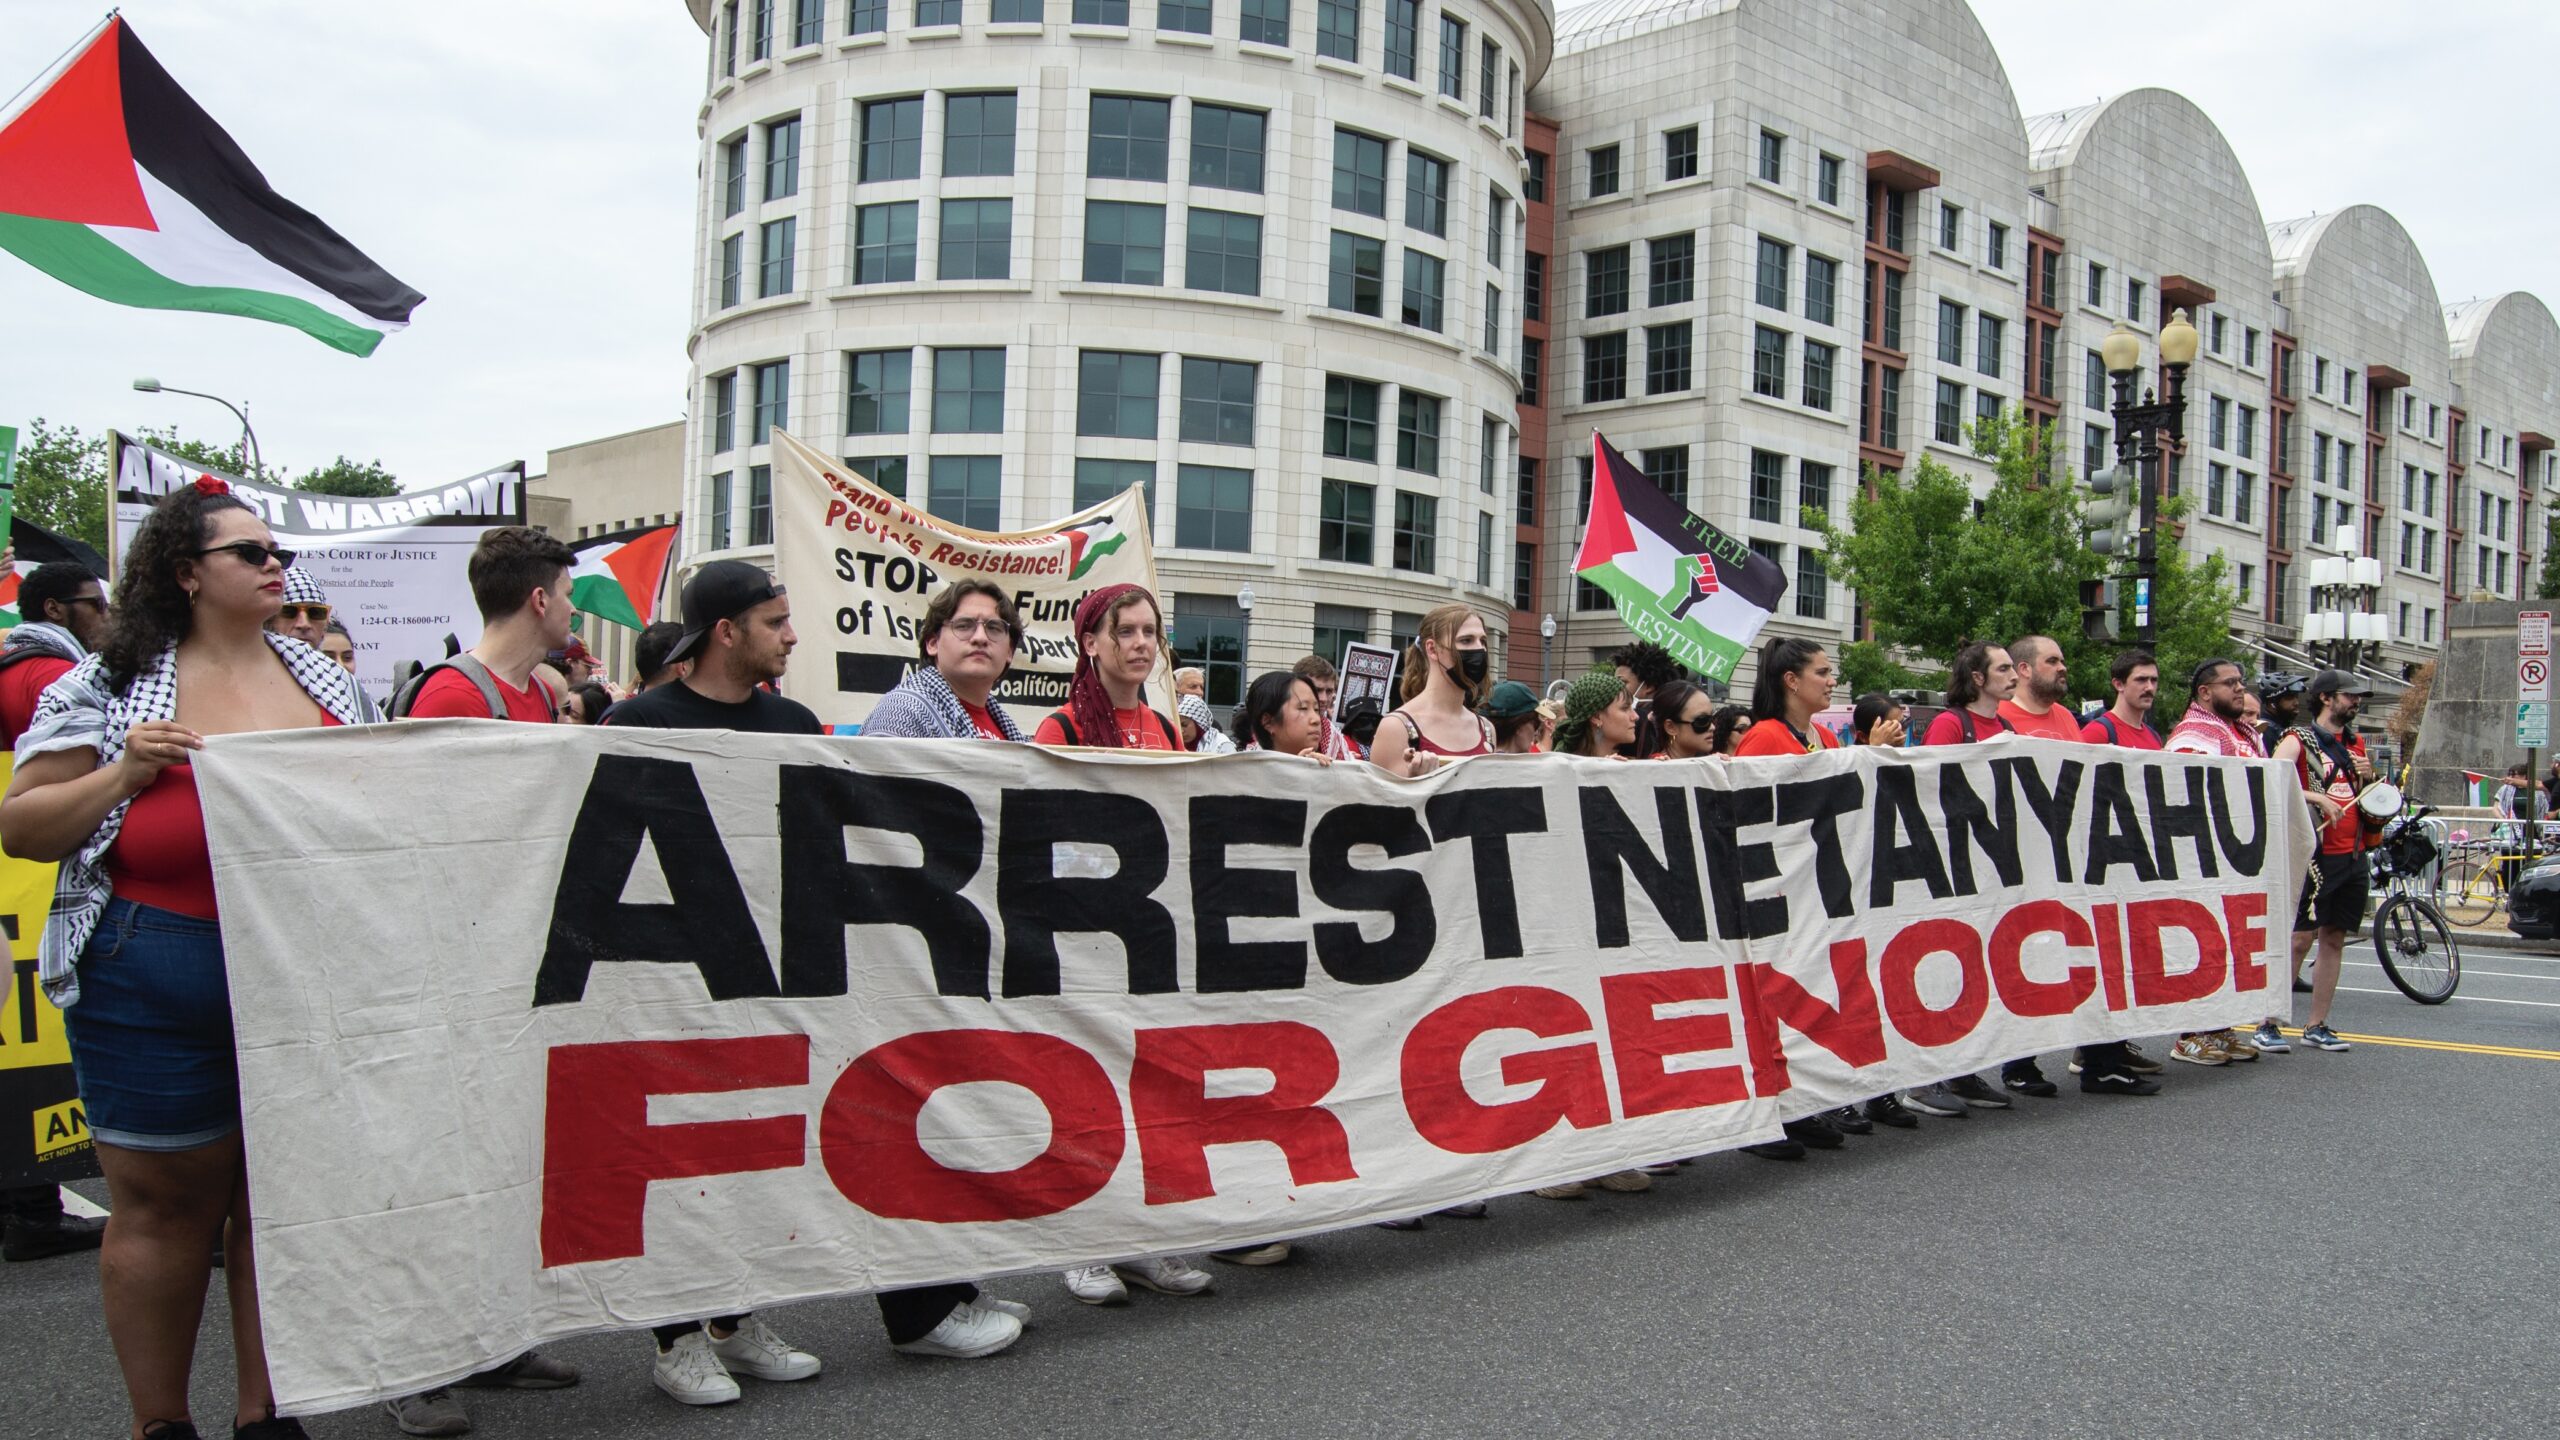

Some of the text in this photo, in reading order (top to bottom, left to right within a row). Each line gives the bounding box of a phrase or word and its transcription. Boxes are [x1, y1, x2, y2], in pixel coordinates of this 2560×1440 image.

[118, 445, 521, 531] ARST WARRANT
[328, 548, 372, 560] COURT
[390, 549, 438, 560] JUSTICE
[929, 542, 1066, 576] Resistance!
[1680, 512, 1752, 570] FREE
[320, 579, 394, 588] District of the People
[835, 547, 938, 595] STOP
[360, 615, 451, 625] 1:24-CR-186000-PCJ
[836, 599, 873, 636] of
[1612, 586, 1729, 678] ALESTINE
[532, 753, 2267, 1007] ARREST NETANYAHU
[540, 892, 2268, 1268] FOR GENOCIDE
[38, 1152, 55, 1163] ACT
[55, 1145, 77, 1158] NOW
[78, 1141, 90, 1151] TO
